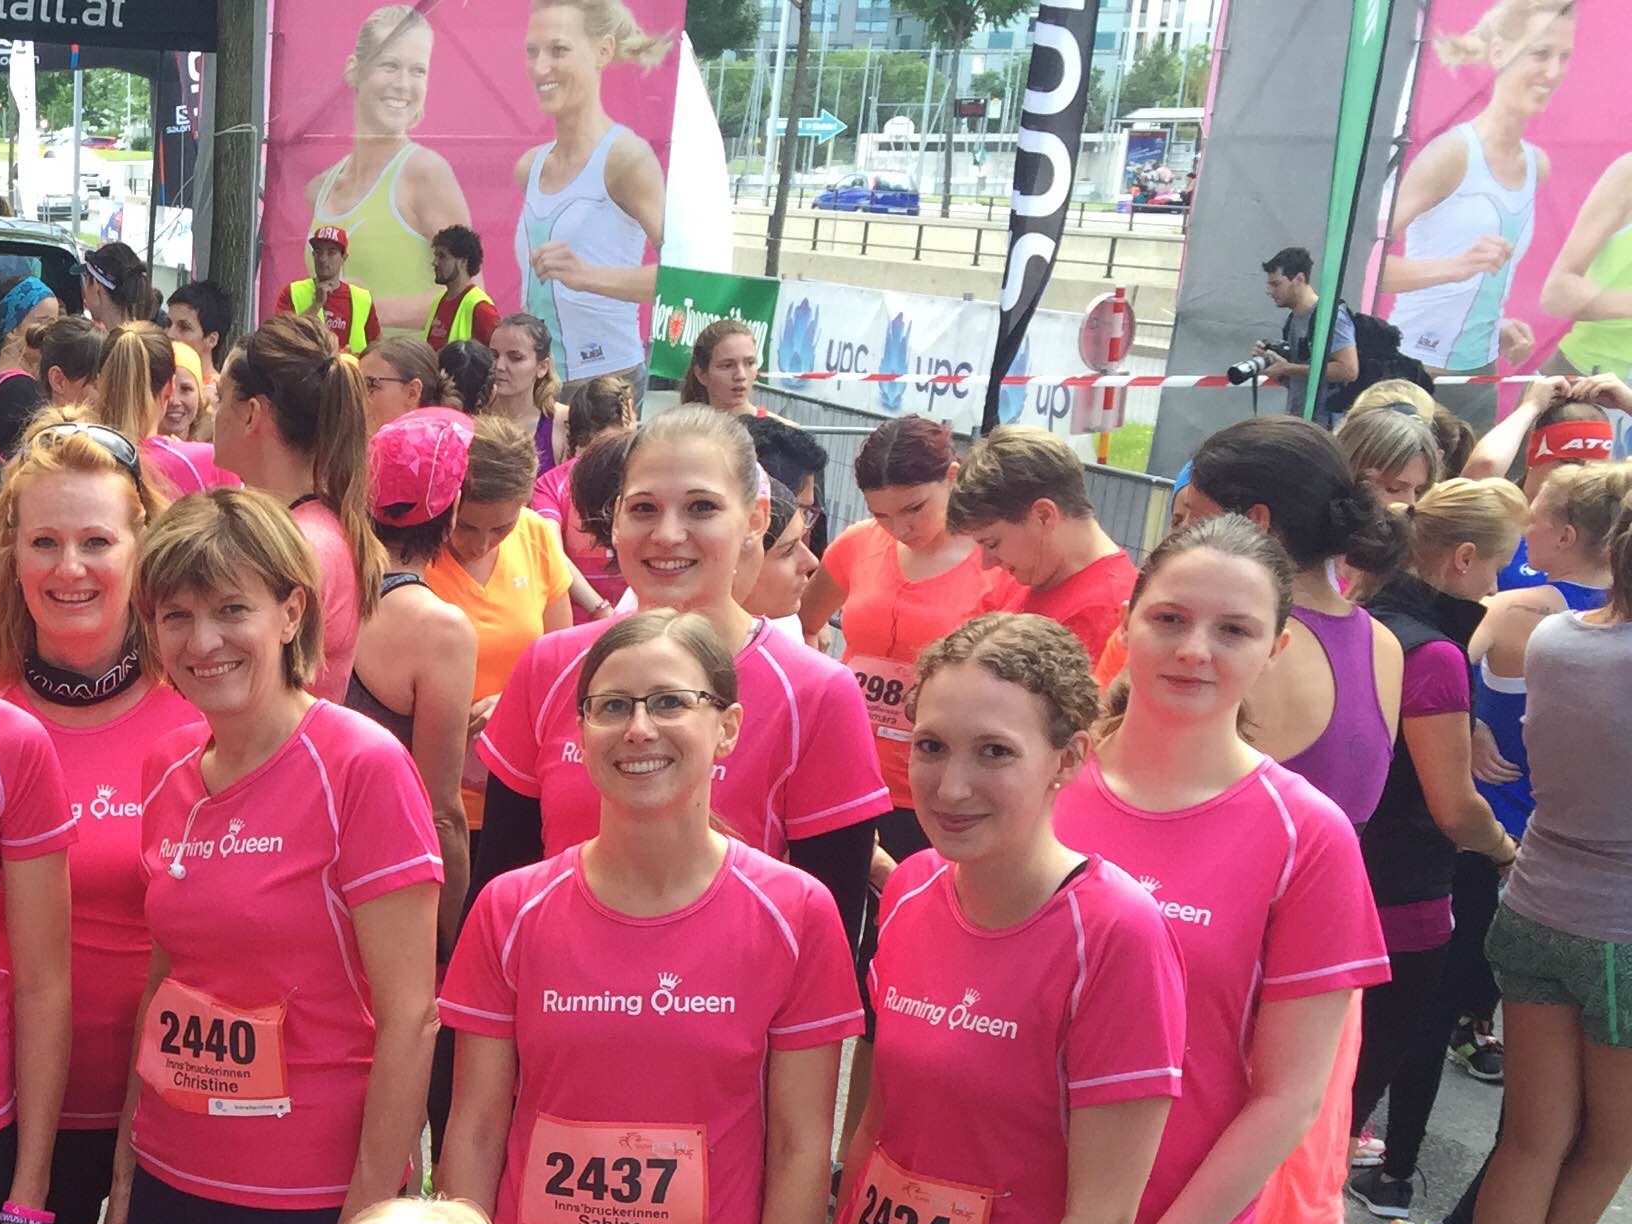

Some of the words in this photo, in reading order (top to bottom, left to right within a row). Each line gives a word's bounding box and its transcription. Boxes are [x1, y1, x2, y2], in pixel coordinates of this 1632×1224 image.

[916, 355, 974, 412] upc
[1036, 384, 1071, 433] up
[219, 833, 283, 857] Queen
[542, 990, 642, 1015] Running
[650, 989, 735, 1016] Queen
[884, 986, 947, 1025] Running
[948, 1004, 1018, 1039] Queen
[160, 1010, 256, 1065] 2440
[173, 1071, 239, 1093] Christine
[545, 1151, 678, 1205] 2437
